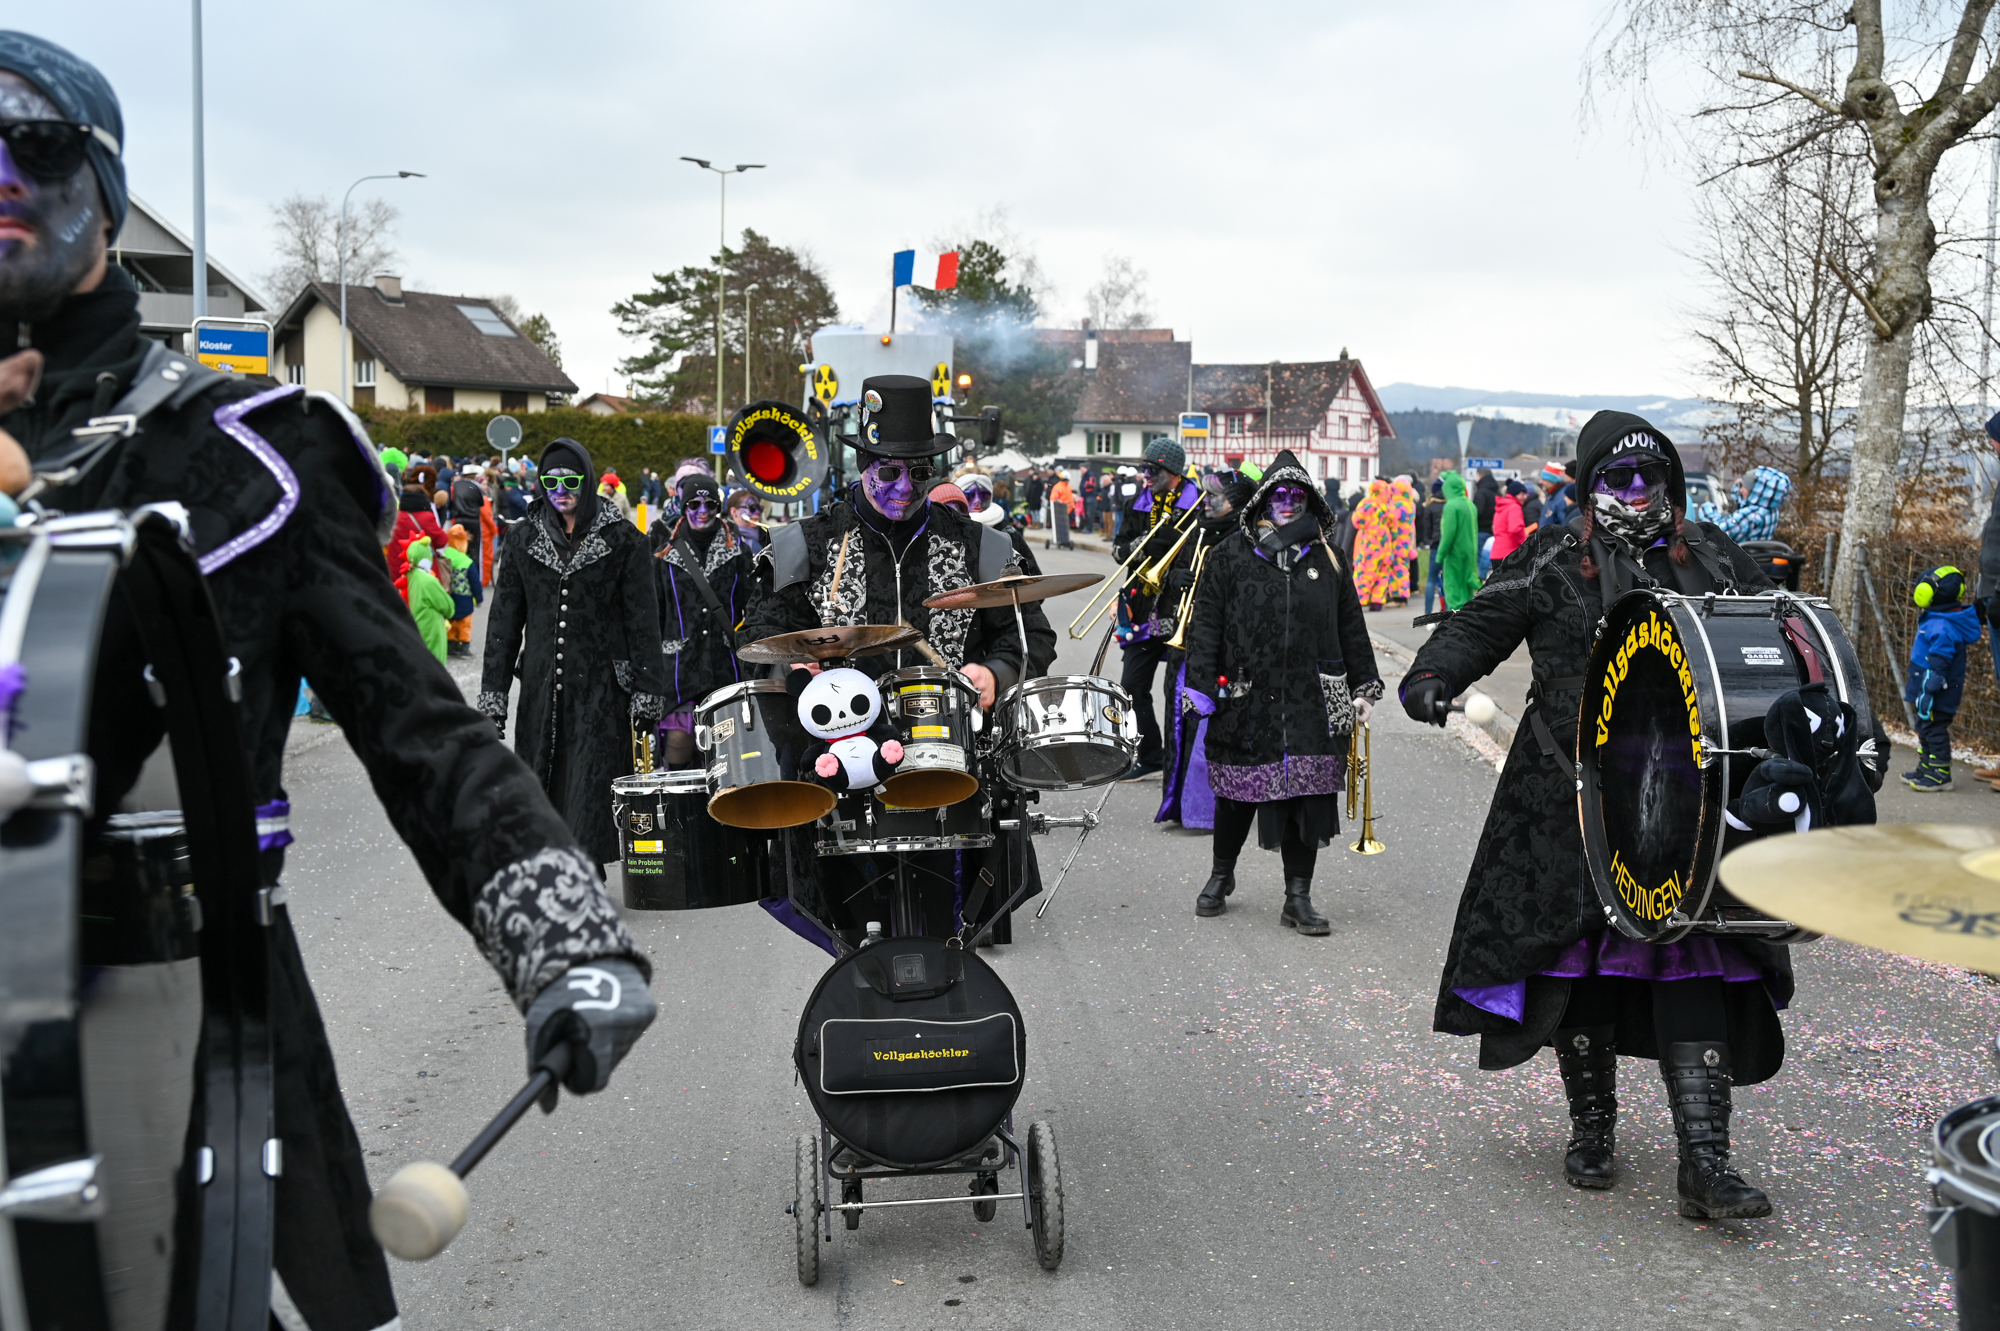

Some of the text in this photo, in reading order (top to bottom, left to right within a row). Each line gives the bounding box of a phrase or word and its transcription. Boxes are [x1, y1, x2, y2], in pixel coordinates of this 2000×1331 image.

[199, 340, 233, 351] Kloster
[745, 472, 812, 496] Hedingen
[1610, 849, 1682, 921] HEDINGEN
[872, 1047, 970, 1062] Vollgashöckler
